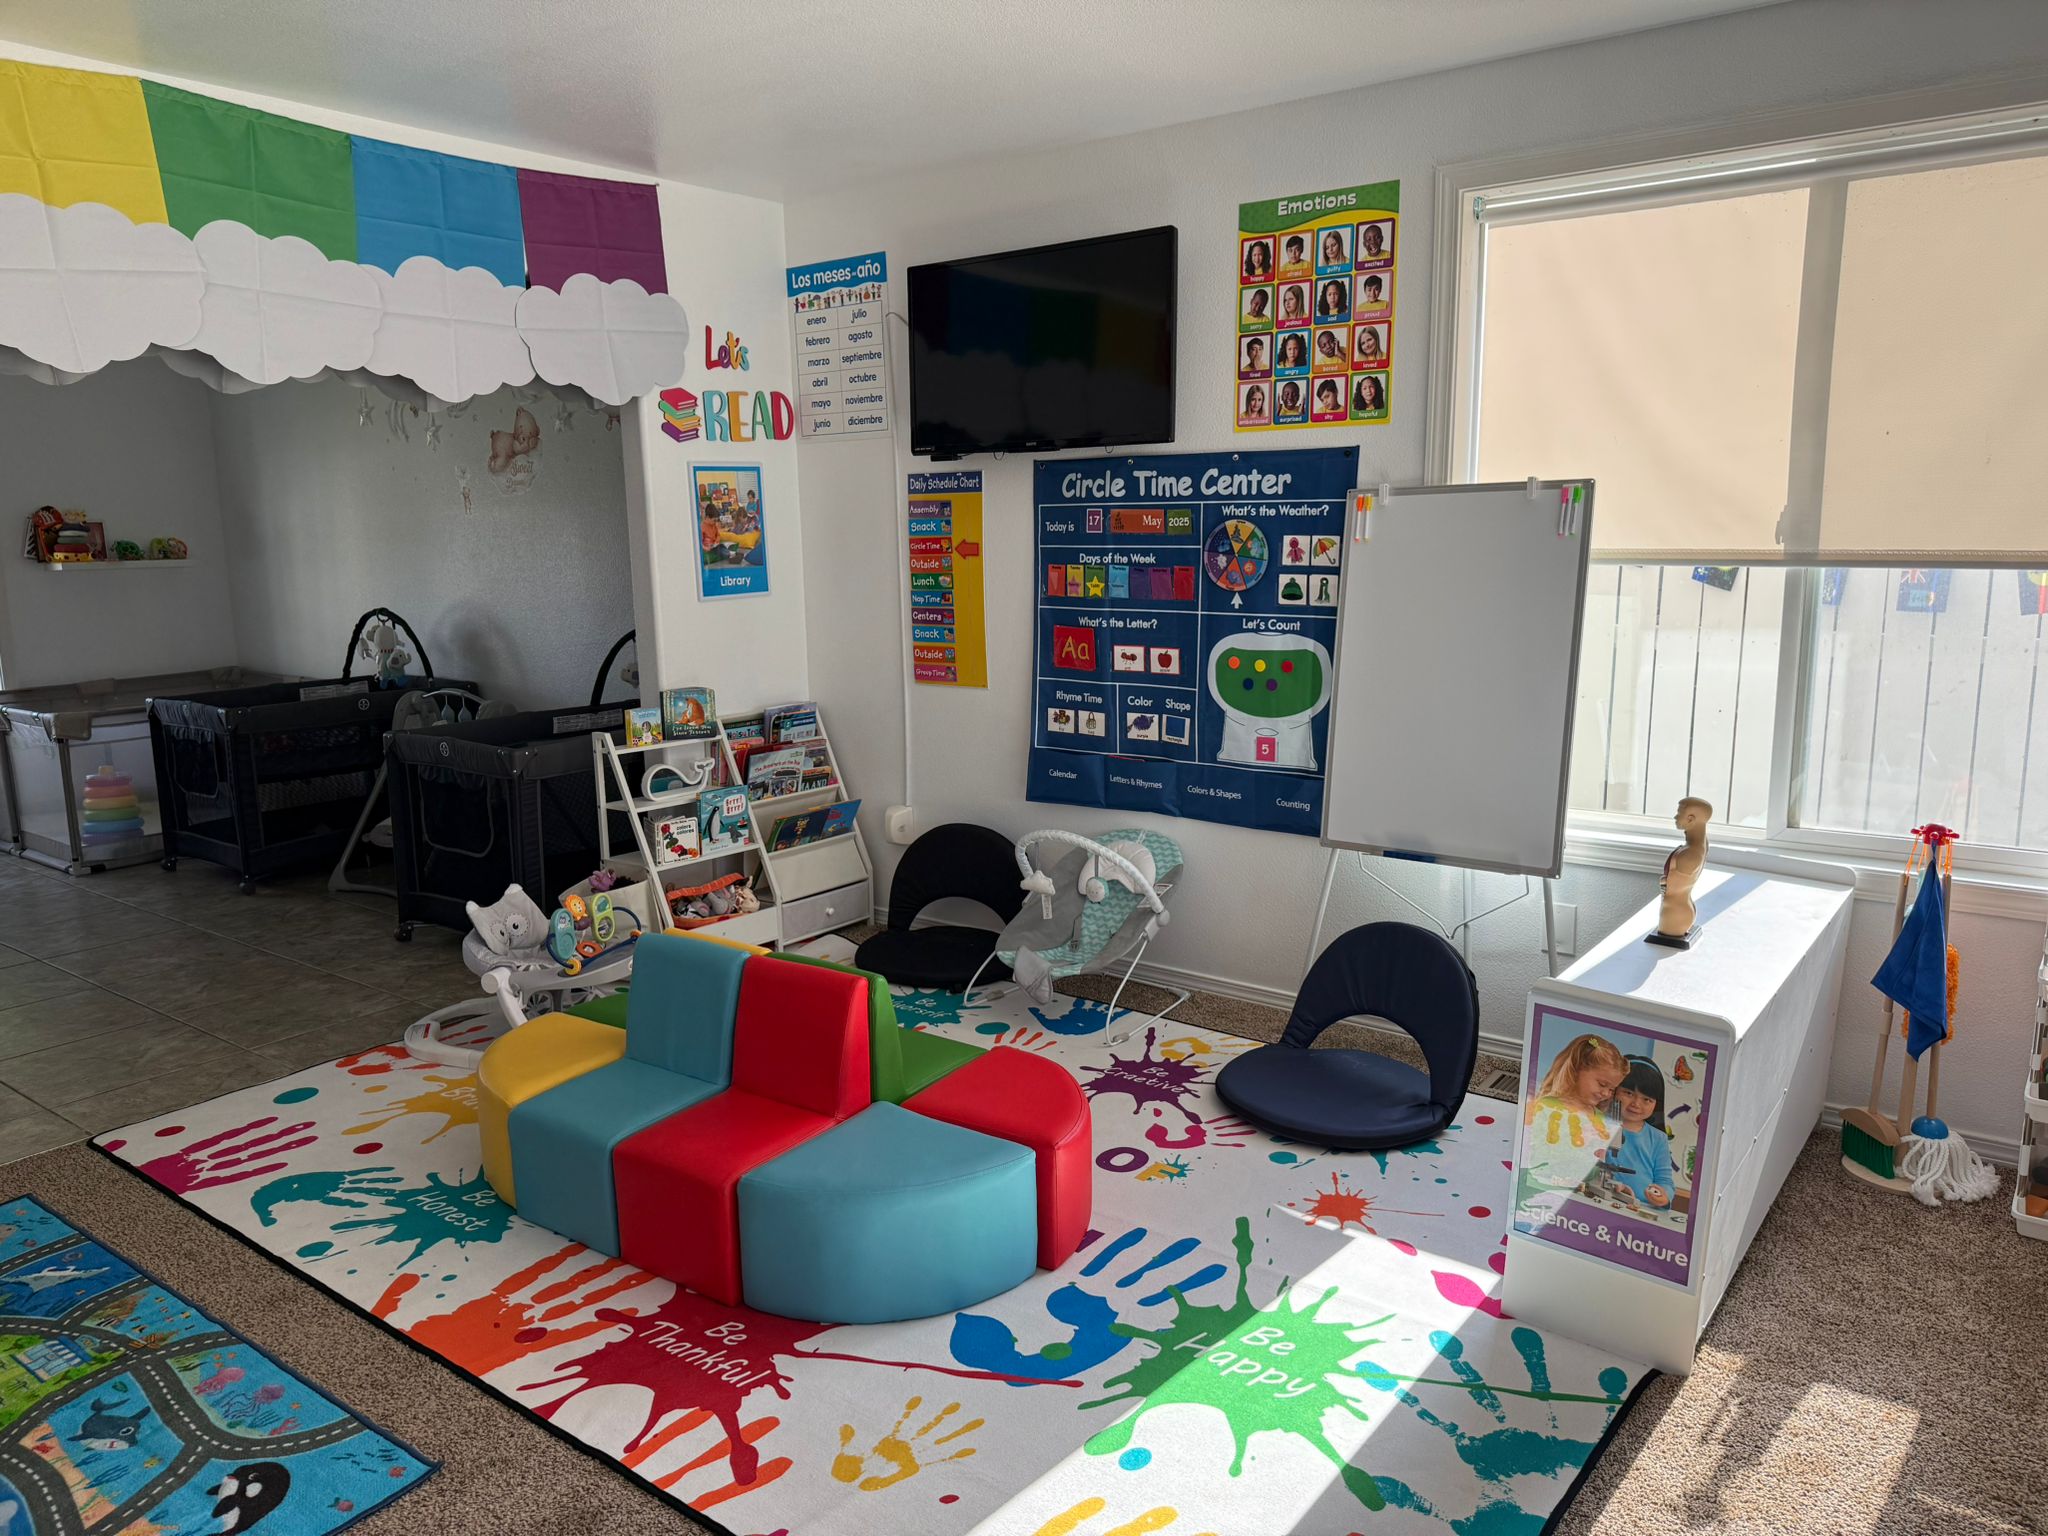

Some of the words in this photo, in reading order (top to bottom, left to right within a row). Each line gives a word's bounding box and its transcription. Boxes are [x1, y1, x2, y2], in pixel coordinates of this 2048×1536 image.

[1277, 192, 1357, 217] Emotions
[792, 272, 811, 290] Los
[813, 266, 851, 286] meses
[857, 260, 881, 279] año
[806, 316, 827, 326] enero
[851, 310, 867, 324] julio
[805, 335, 831, 348] febrero
[848, 329, 873, 344] agosto
[705, 324, 750, 371] Let's
[807, 357, 830, 367] marzo
[841, 349, 882, 365] septiembre
[812, 377, 828, 388] abril
[848, 372, 877, 384] octubre
[811, 398, 831, 411] mayo
[845, 393, 883, 406] noviembre
[702, 390, 794, 442] READ
[848, 414, 883, 426] diciembre
[812, 419, 831, 432] junio
[909, 477, 926, 493] Daily
[927, 475, 959, 490] Schedule
[959, 475, 980, 488] Chart
[1061, 469, 1126, 499] Circle
[1132, 468, 1193, 497] Time
[1200, 467, 1292, 496] Center
[909, 505, 940, 516] Assembly
[1221, 504, 1257, 517] What's
[1259, 505, 1276, 517] the
[1279, 504, 1330, 517] Weather?
[910, 521, 937, 532] Snack
[1045, 521, 1067, 534] Today
[1068, 521, 1075, 532] is
[1088, 515, 1100, 526] 17
[1142, 515, 1162, 529] May
[1168, 517, 1190, 527] 2025
[910, 542, 926, 550] Circle
[926, 541, 941, 551] Time
[910, 558, 940, 569] Outside
[1079, 553, 1101, 566] Days
[1102, 552, 1113, 564] of
[1113, 553, 1129, 564] the
[1130, 553, 1156, 564] Week
[720, 574, 751, 588] Library
[912, 575, 935, 586] Lunch
[912, 594, 925, 605] Nap
[925, 594, 941, 604] Time
[912, 611, 942, 622] Centers
[1078, 617, 1109, 630] What's
[1109, 617, 1125, 630] the
[1126, 618, 1158, 631] Letter?
[1242, 618, 1265, 630] Let's
[1266, 619, 1301, 632] Count
[914, 628, 940, 639] Snack
[914, 649, 944, 660] Outside
[1061, 635, 1090, 661] Aa
[1056, 690, 1082, 703] Rhyme
[1084, 692, 1103, 704] Time
[1127, 695, 1154, 707] Color
[1165, 698, 1191, 713] Shape
[1261, 744, 1270, 756] 5
[1048, 768, 1078, 780] Calendar
[1109, 774, 1130, 786] Letters
[1130, 777, 1136, 787] &
[1136, 778, 1163, 791] Rhymes
[1187, 785, 1209, 797] Colors
[1209, 788, 1215, 798] &
[1215, 789, 1242, 802] Shapes
[1276, 797, 1311, 812] Counting
[1142, 1066, 1169, 1078] Be
[461, 1189, 497, 1208] Be
[407, 1190, 491, 1232] Honest
[1519, 1199, 1591, 1237] Science
[1594, 1224, 1611, 1244] &
[1616, 1230, 1689, 1267] Nature
[704, 1321, 748, 1346] Be
[1239, 1326, 1297, 1356] Be
[639, 1321, 772, 1388] Thankful
[1173, 1331, 1318, 1399] Happy
